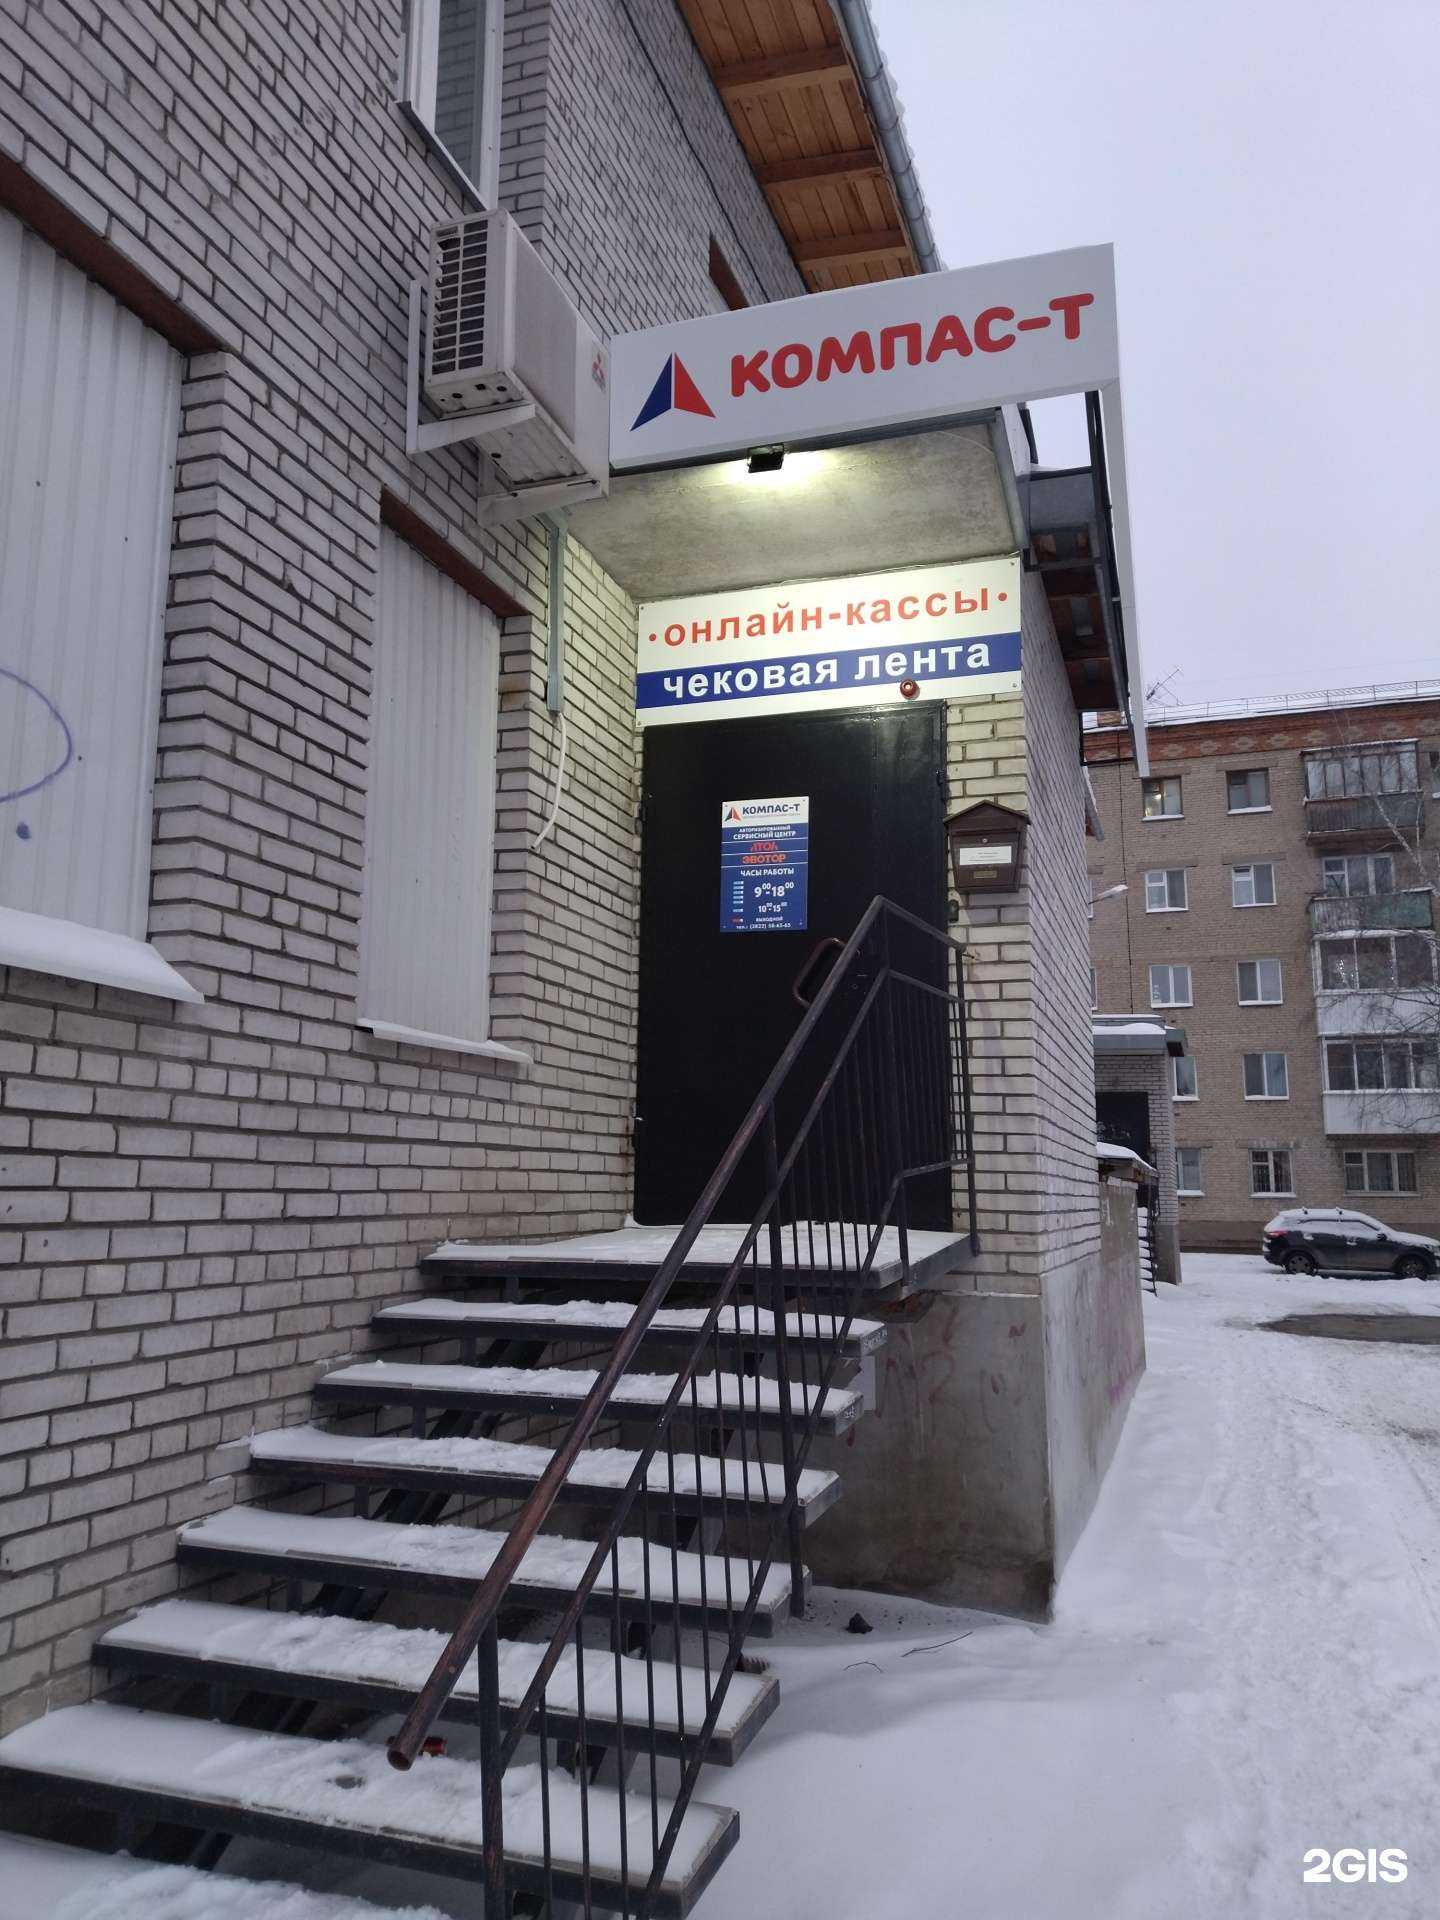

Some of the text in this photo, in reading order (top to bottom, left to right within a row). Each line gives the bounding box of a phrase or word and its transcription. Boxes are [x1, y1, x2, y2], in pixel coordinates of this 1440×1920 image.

[731, 293, 1094, 398] КОМПАС-Т
[663, 642, 990, 699] чековая лента
[742, 803, 801, 815] КОМПАС-Т
[733, 830, 797, 840] СЕРВИСНЫЙ ЦЕНТР
[742, 853, 786, 864] ЭВОТОР
[740, 867, 794, 877] ЧАСЫ РАБОТЫ
